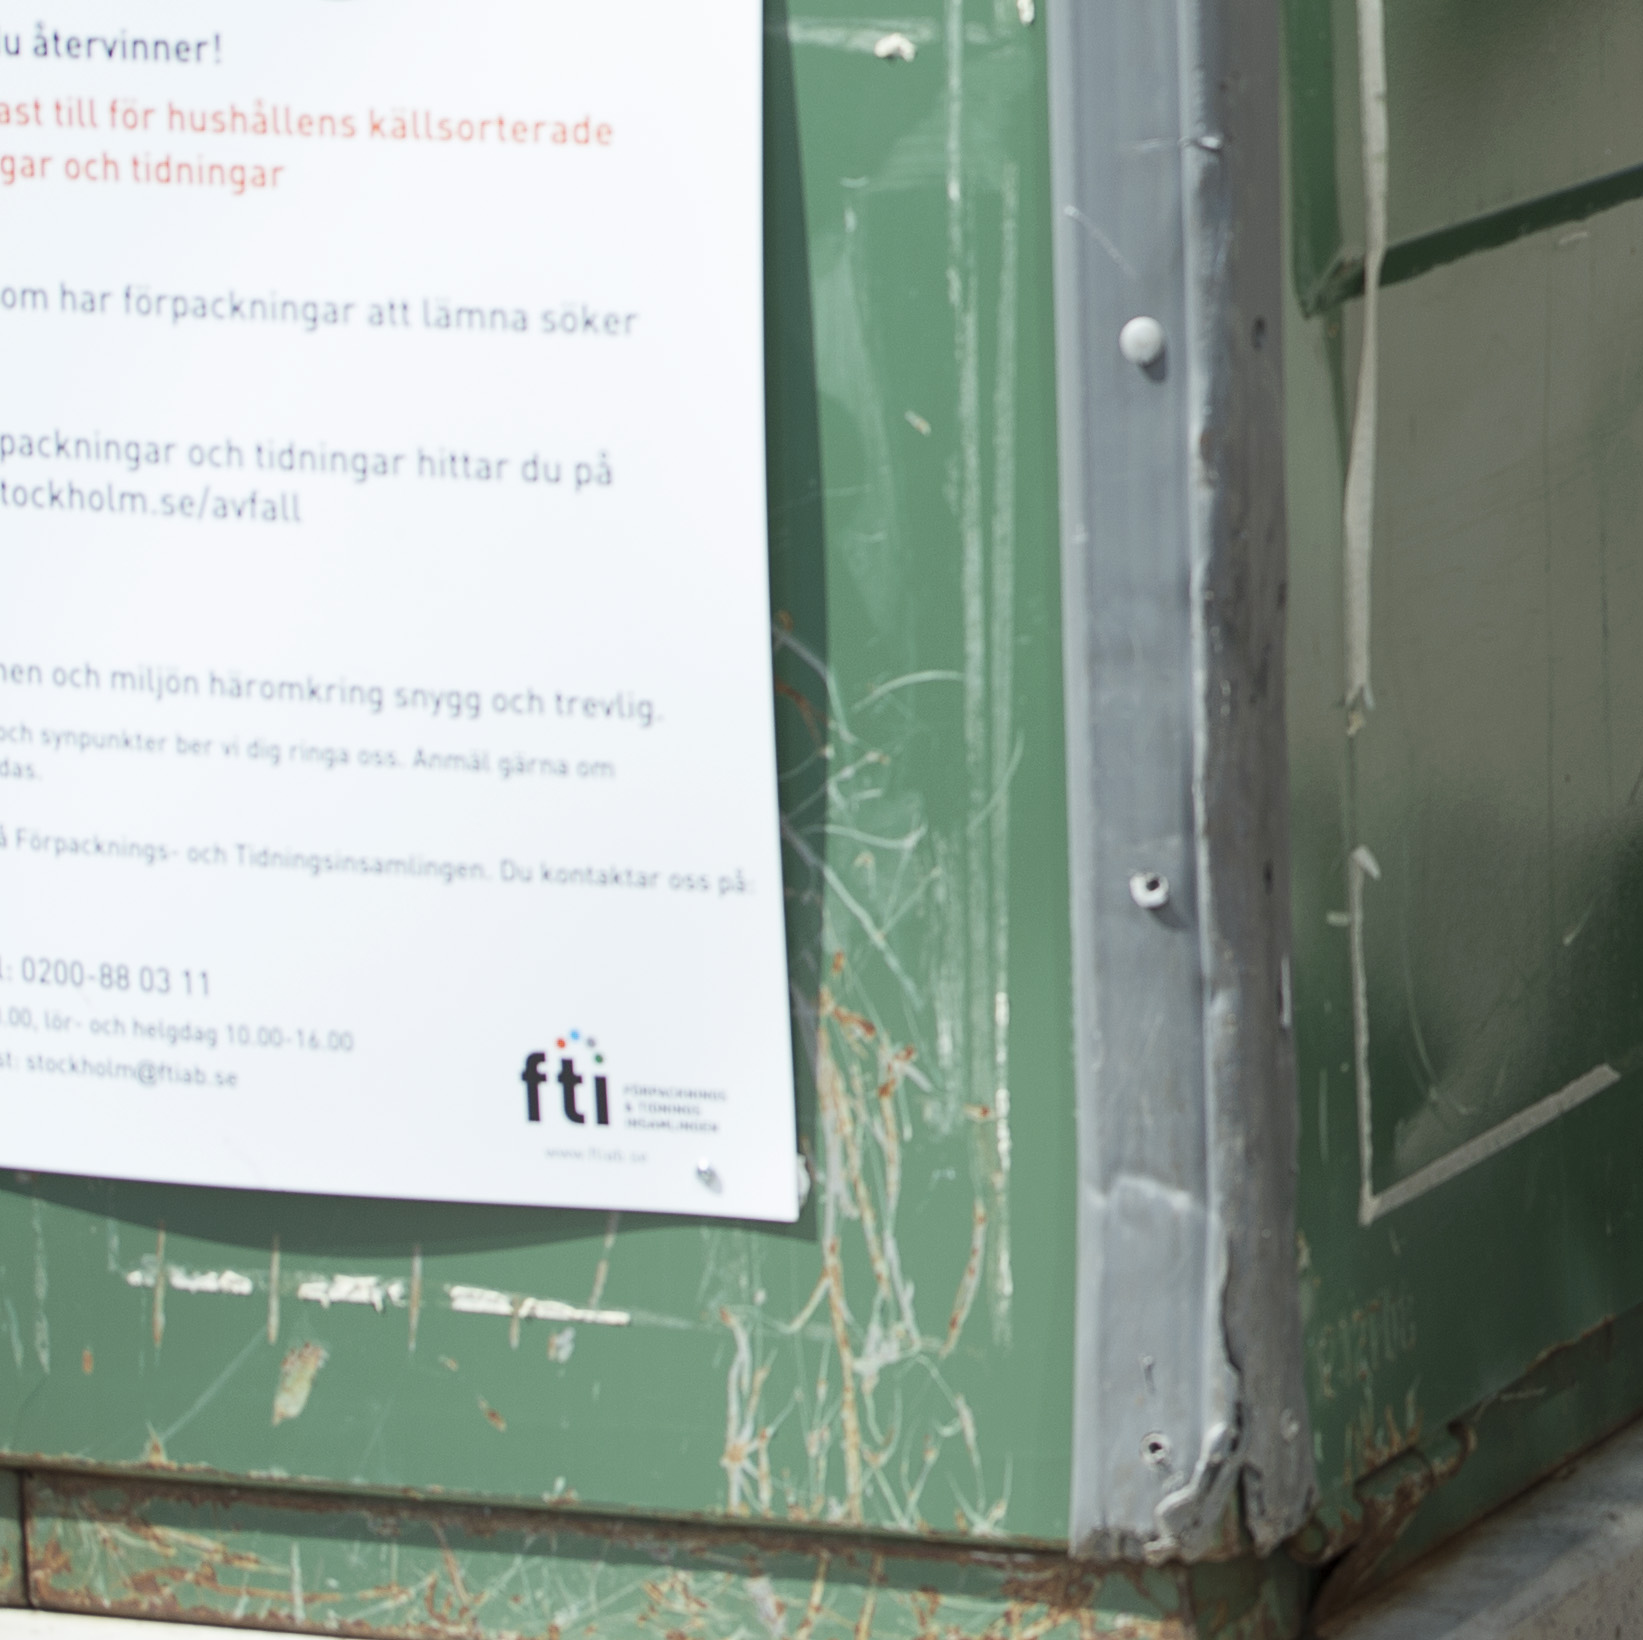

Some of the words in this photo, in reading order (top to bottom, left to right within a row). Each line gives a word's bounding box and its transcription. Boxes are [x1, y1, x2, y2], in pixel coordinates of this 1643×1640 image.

[0, 33, 21, 58] u
[34, 19, 223, 65] återvinner!
[0, 97, 41, 126] ast
[54, 96, 98, 129] till
[109, 97, 156, 130] för
[167, 98, 357, 139] hushållens
[369, 108, 615, 148] källsorterade
[0, 154, 52, 186] gar
[64, 152, 120, 182] och
[132, 151, 285, 196] tidningar
[59, 282, 111, 314] har
[123, 283, 357, 332] förpackningar
[366, 298, 411, 328] att
[422, 298, 529, 332] lämna
[540, 300, 640, 337] söker
[0, 429, 178, 472] packningar
[187, 437, 245, 469] och
[254, 438, 406, 484] tidningar
[416, 447, 509, 484] hittar
[520, 452, 563, 485] du
[574, 452, 614, 493] på
[0, 478, 303, 525] tockholm.se/avfall
[51, 661, 101, 690] och
[110, 664, 200, 701] miljön
[208, 668, 384, 715] häromkring
[394, 683, 483, 720] snygg
[491, 688, 546, 716] och
[554, 692, 664, 729] trevlig.
[41, 728, 166, 754] synpunkter
[175, 733, 213, 757] ber
[221, 734, 240, 757] vi
[246, 736, 283, 768] dig
[288, 741, 350, 771] ringa
[357, 746, 403, 768] oss.
[412, 748, 491, 774] Anmäl
[498, 753, 569, 780] gärna
[576, 759, 617, 780] om
[15, 826, 180, 867] Förpacknings-
[186, 843, 228, 866] och
[235, 842, 490, 886] Tidningsinsamlingen.
[500, 859, 535, 883] Du
[540, 860, 658, 890] kontaktar
[668, 870, 711, 893] oss
[21, 955, 131, 991] 0200-88
[139, 964, 172, 995] 03
[182, 968, 211, 998] 11
[0, 1006, 39, 1034] .00,
[43, 1010, 83, 1032] lör-
[90, 1015, 127, 1038] och
[132, 1019, 219, 1051] helgdag
[226, 1022, 356, 1053] 10.00-16.00
[26, 1052, 239, 1088] stockholm@ftiab.se
[520, 1051, 610, 1126] fti
